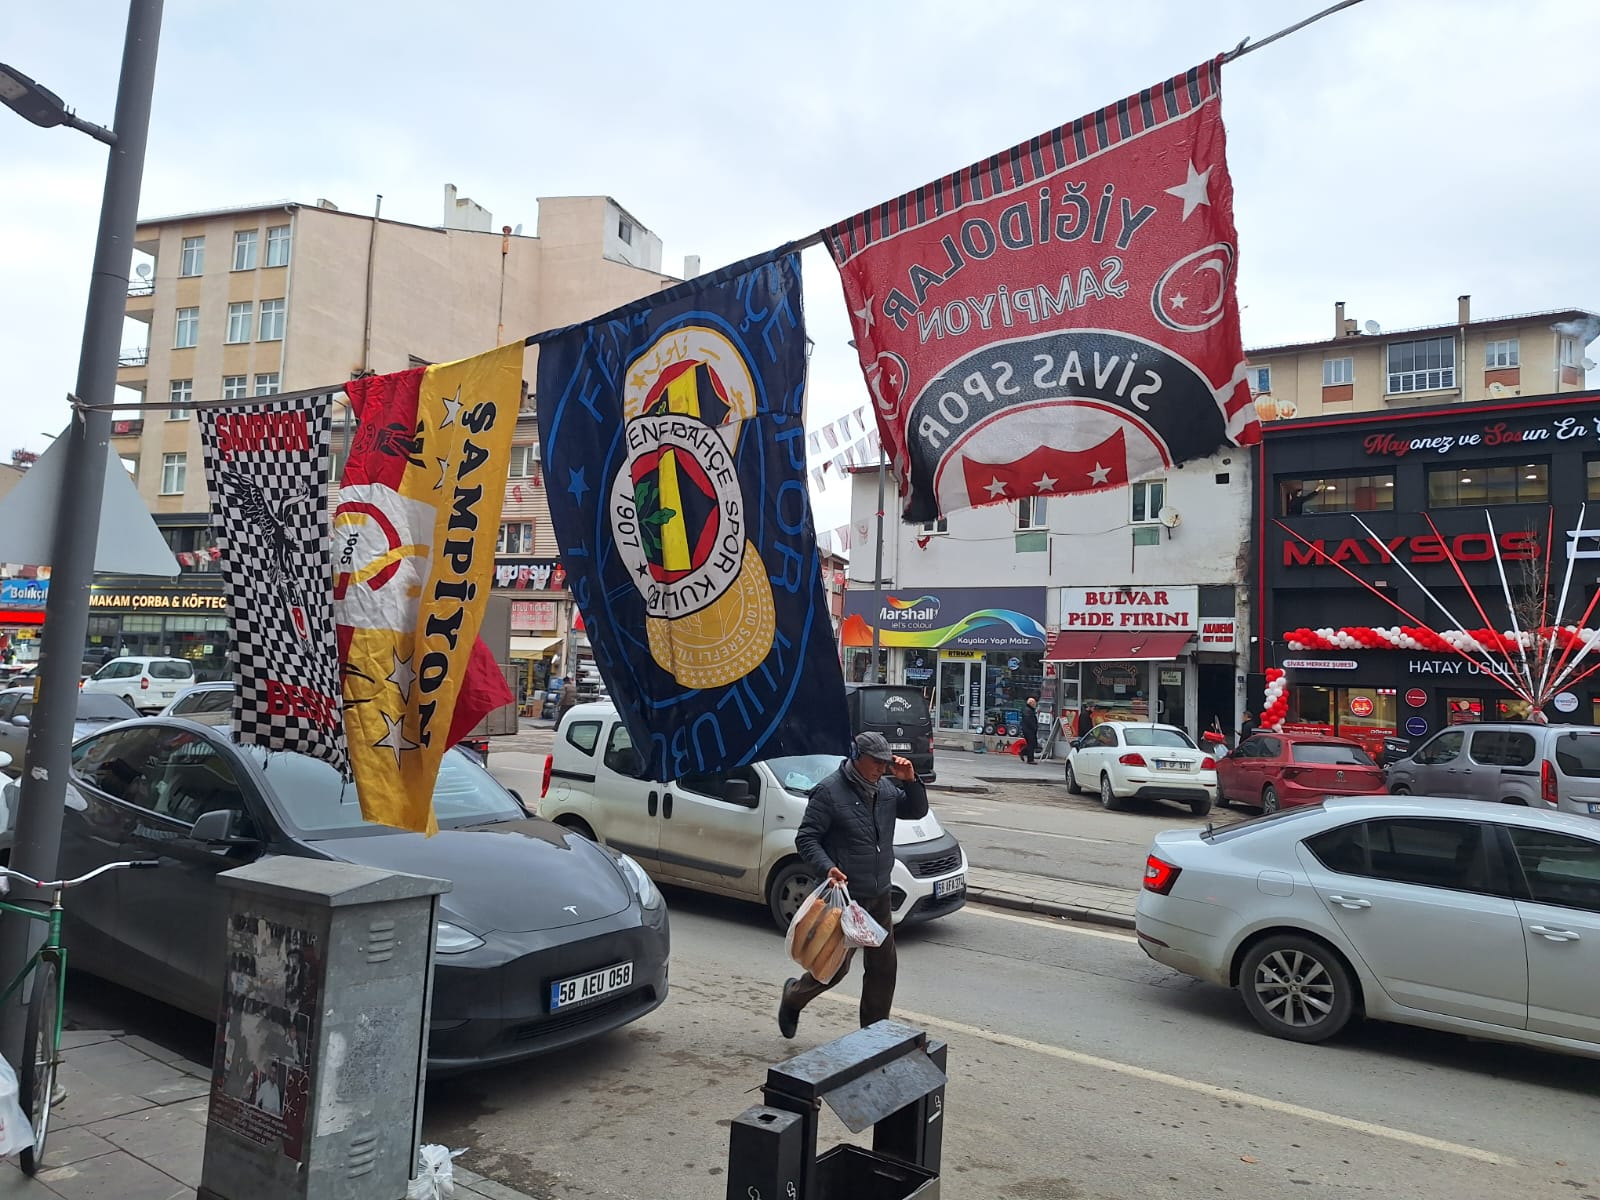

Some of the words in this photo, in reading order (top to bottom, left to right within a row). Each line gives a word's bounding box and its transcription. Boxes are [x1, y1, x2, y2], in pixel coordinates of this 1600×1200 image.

[1363, 433, 1456, 457] Mayonez
[1458, 432, 1481, 447] ve
[1483, 422, 1550, 446] Sosun
[1553, 417, 1588, 440] En
[713, 500, 739, 574] SPOR
[1283, 530, 1543, 567] MAYSOS
[89, 595, 131, 607] MAKAM
[132, 595, 169, 610] ÇORBA
[172, 596, 180, 607] &
[182, 593, 227, 609] KÖFTEC
[1085, 591, 1169, 606] BULVAR
[907, 620, 933, 629] colour
[1119, 612, 1190, 627] FIRINI
[957, 637, 989, 645] Kayalar
[989, 637, 1008, 645] Yapı
[1305, 660, 1331, 668] MERKEZ
[1409, 660, 1463, 674] HATAY
[560, 981, 576, 1003] 58
[582, 972, 605, 998] AEU
[609, 965, 630, 988] 058
